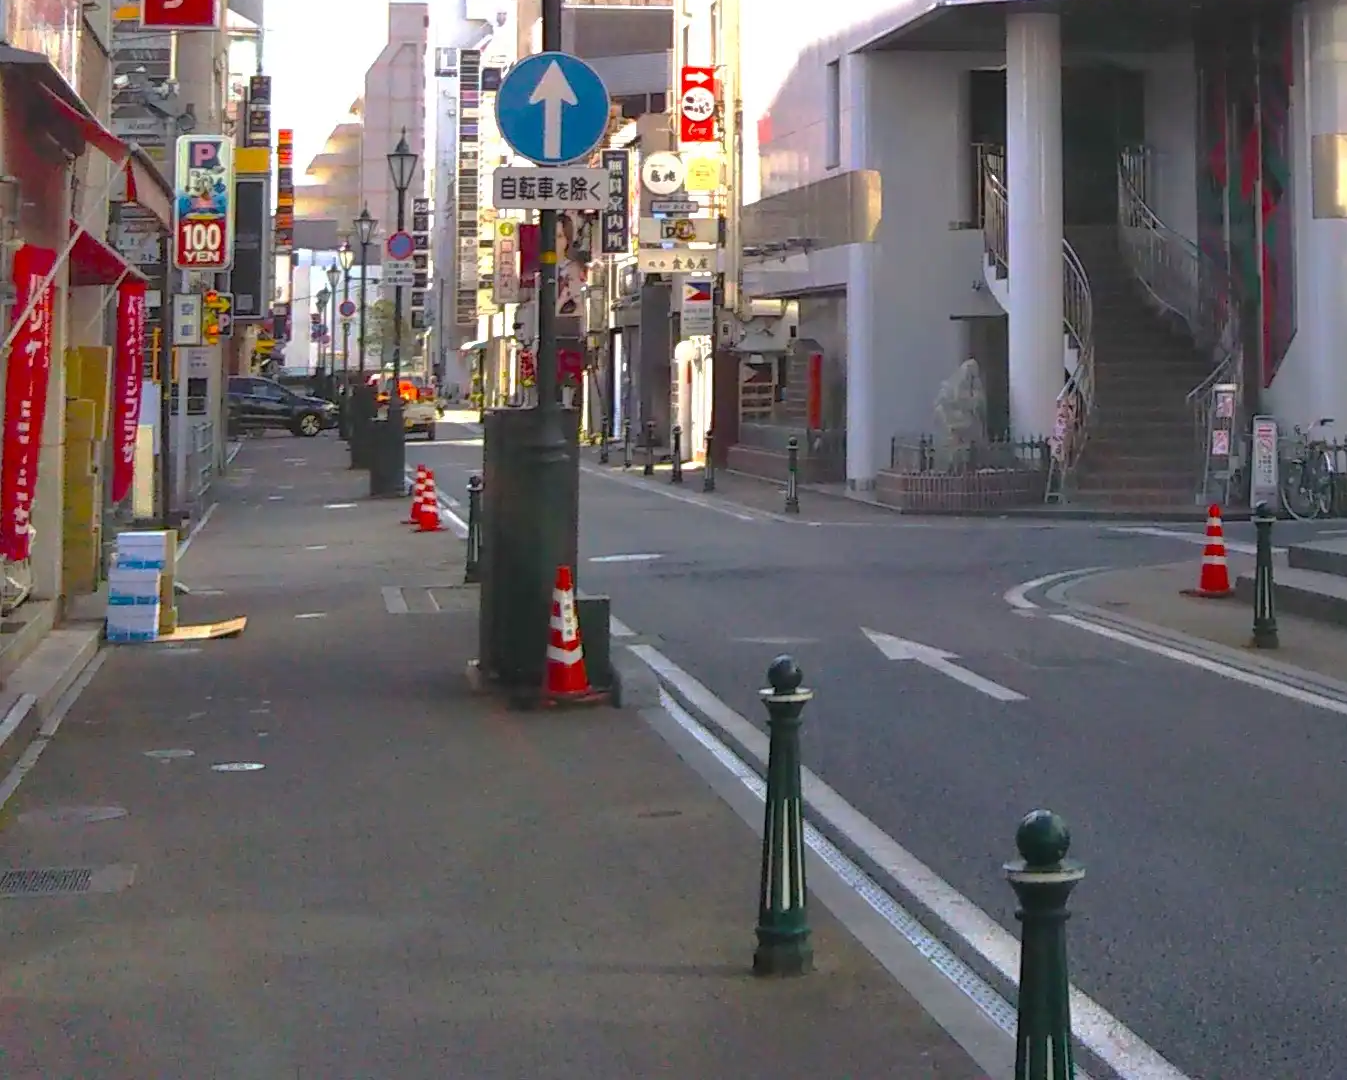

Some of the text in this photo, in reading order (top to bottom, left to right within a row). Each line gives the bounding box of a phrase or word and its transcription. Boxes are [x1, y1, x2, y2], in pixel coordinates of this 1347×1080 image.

[500, 176, 602, 201] 自転車を除く
[182, 223, 222, 251] 100
[182, 250, 221, 264] YEN
